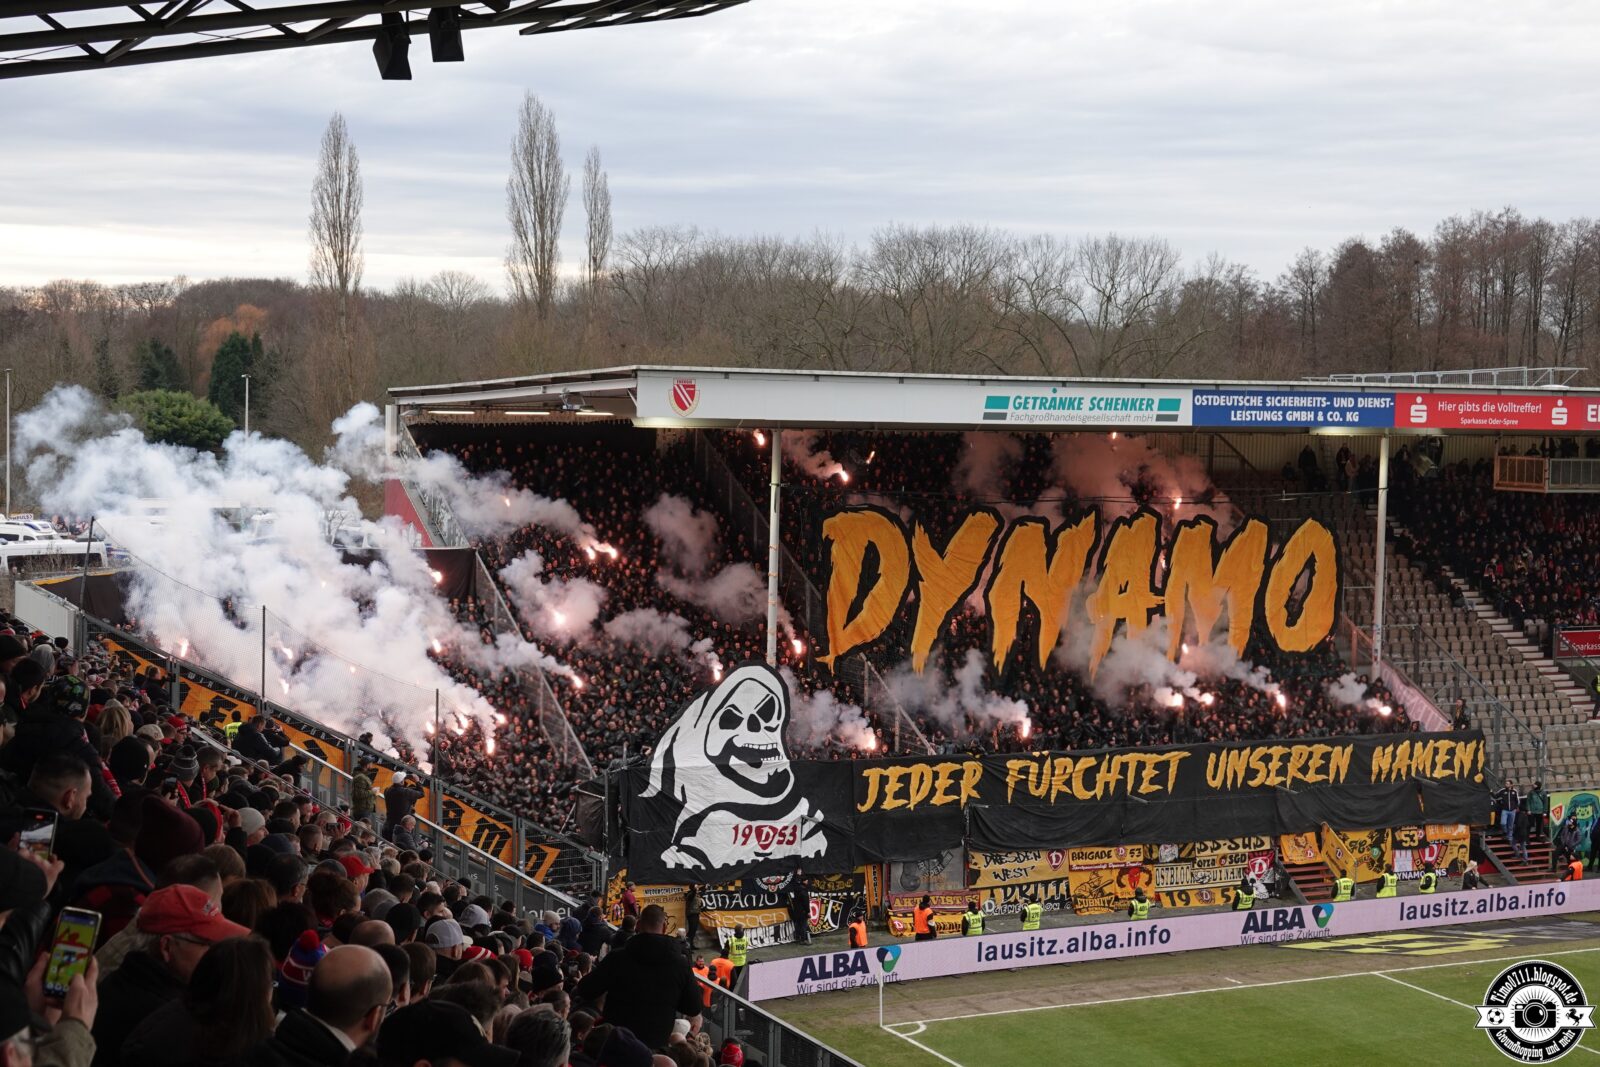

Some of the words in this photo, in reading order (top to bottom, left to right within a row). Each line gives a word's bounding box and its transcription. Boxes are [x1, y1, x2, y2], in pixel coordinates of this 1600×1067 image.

[1013, 388, 1084, 410] GETRÄNKE
[1089, 397, 1154, 411] SCHENKER
[1194, 395, 1263, 407] OSTDEUTSCHE
[1265, 396, 1331, 407] SICHERHEITS-
[1333, 397, 1354, 408] UND
[1357, 397, 1394, 408] DIENST-
[1438, 401, 1456, 412] Hier
[1458, 401, 1480, 414] gibts
[1482, 402, 1495, 412] die
[1497, 403, 1542, 413] Volltreffer!
[1010, 413, 1131, 423] Fachgroßhandelsgesellschaft
[1134, 413, 1154, 422] mbH
[1231, 410, 1283, 421] LEISTUNGS
[1286, 411, 1314, 422] GMBH
[1317, 411, 1324, 421] &
[1327, 411, 1343, 422] CO.
[1346, 411, 1359, 422] KG
[1460, 417, 1487, 425] Sparkasse
[1488, 417, 1519, 426] Oder-Spree
[817, 510, 1338, 681] DYNAMO
[857, 761, 983, 812] JEDER
[1006, 751, 1192, 806] FÜRCHTET
[1206, 744, 1353, 791] UNSEREN
[1371, 739, 1485, 784] NAMEN!
[732, 823, 753, 846] 19
[776, 824, 798, 845] 53
[1402, 830, 1419, 847] 53
[983, 849, 1041, 868] DRESDEN
[1071, 850, 1112, 860] BRIGADE
[1129, 848, 1142, 858] 53
[1229, 852, 1247, 864] SGD
[894, 894, 963, 907] AKTVIST
[1165, 889, 1191, 906] 19
[1220, 886, 1238, 903] 5
[1400, 888, 1566, 921] lausitz.alba.info
[1242, 908, 1306, 934] ALBA
[977, 925, 1171, 962] lausitz.alba.info
[1240, 934, 1255, 945] Wir
[1258, 932, 1278, 943] sind
[1280, 930, 1294, 941] die
[797, 950, 870, 983] ALBA
[797, 983, 813, 994] Wir
[817, 980, 838, 991] sind
[841, 976, 857, 987] die
